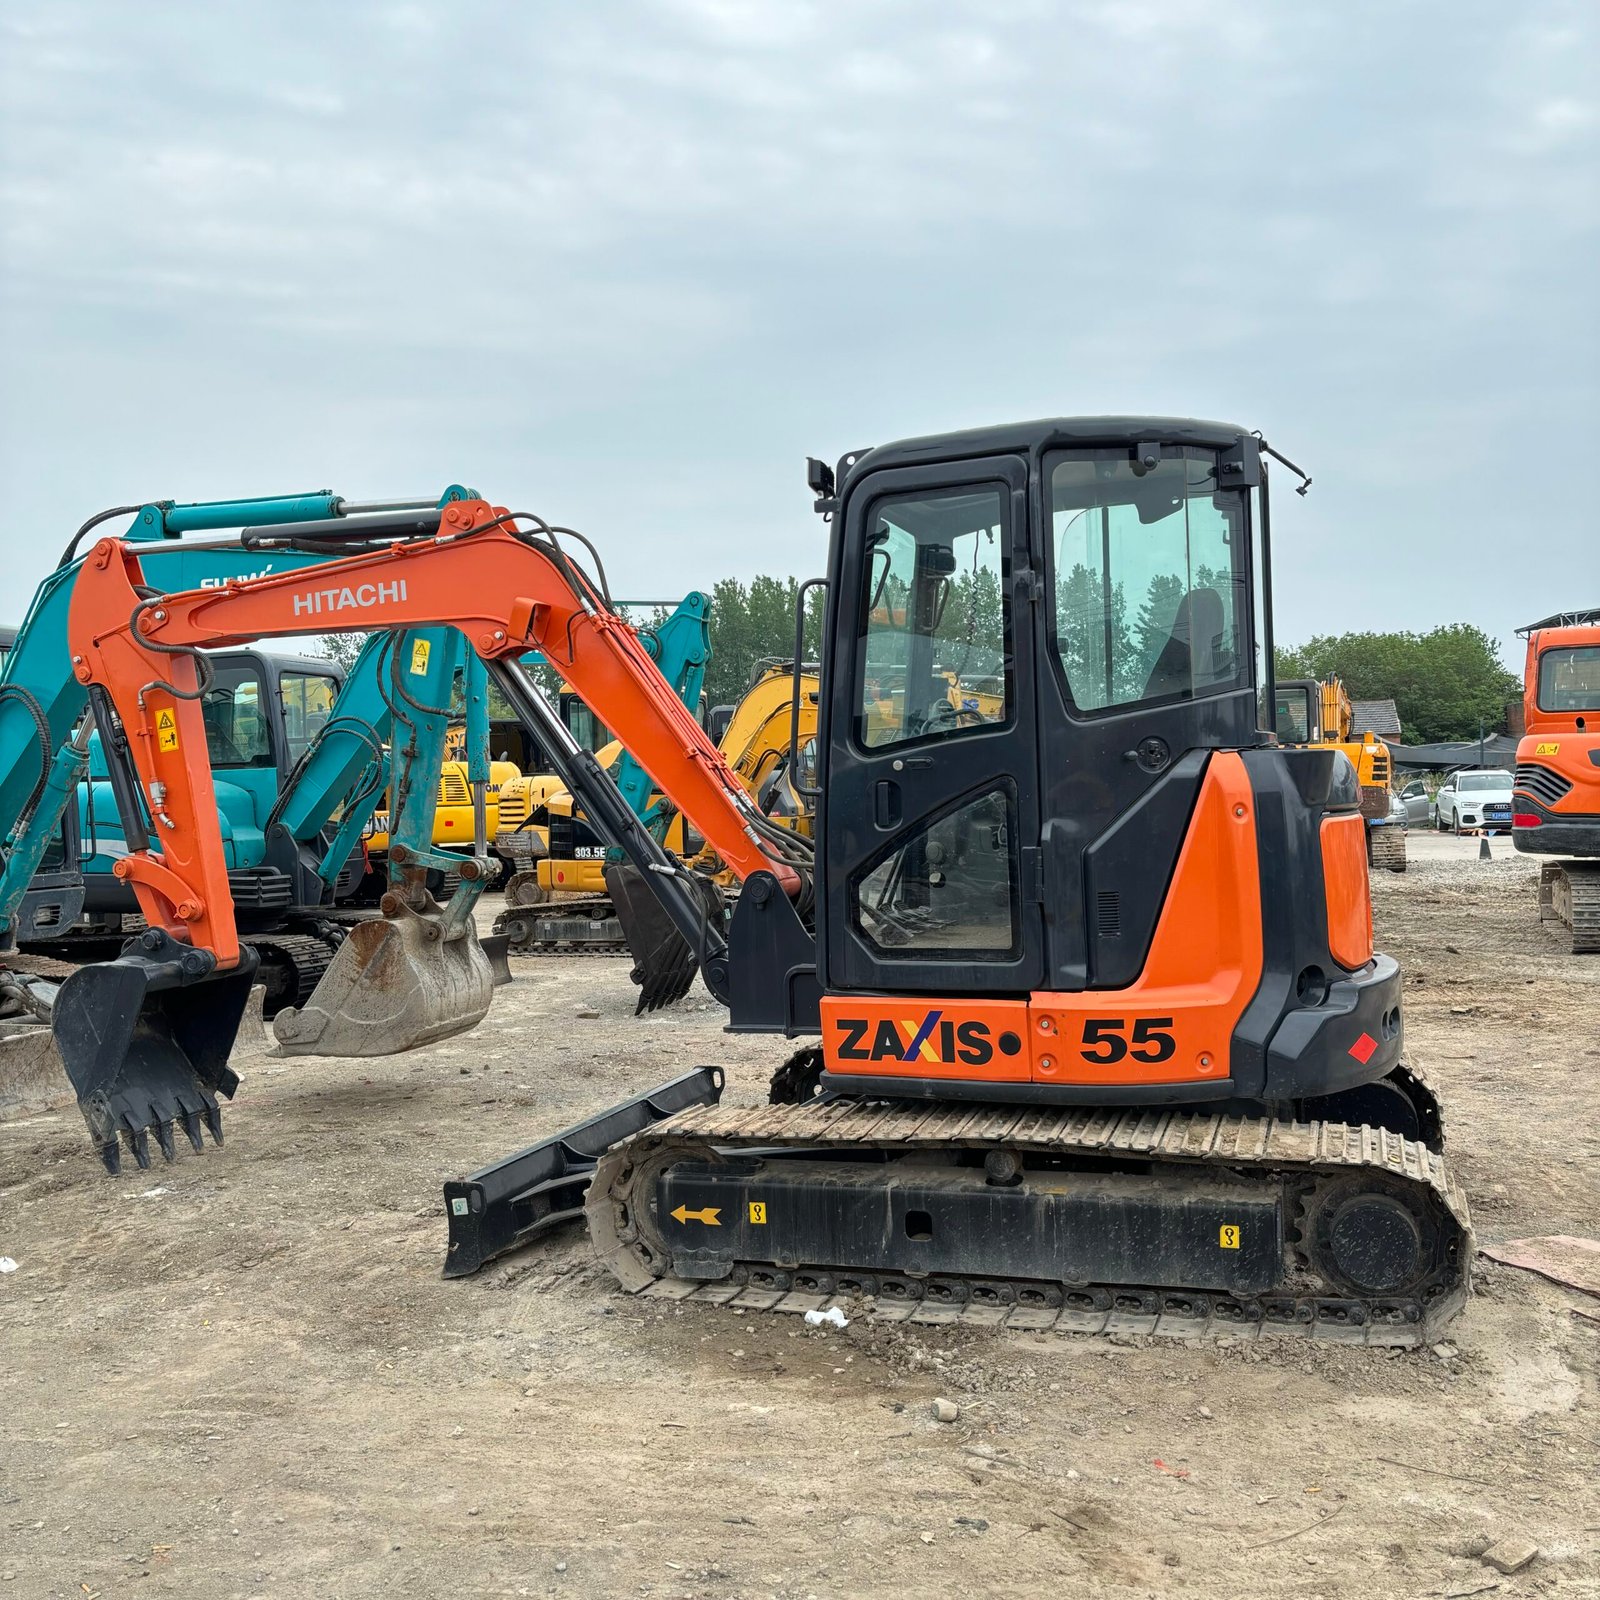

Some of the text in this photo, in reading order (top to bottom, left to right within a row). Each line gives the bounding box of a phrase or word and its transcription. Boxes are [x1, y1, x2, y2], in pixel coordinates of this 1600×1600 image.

[293, 579, 407, 616] HITACHI
[574, 846, 606, 859] 303.5E
[836, 1010, 1176, 1065] ZAXIS 55
